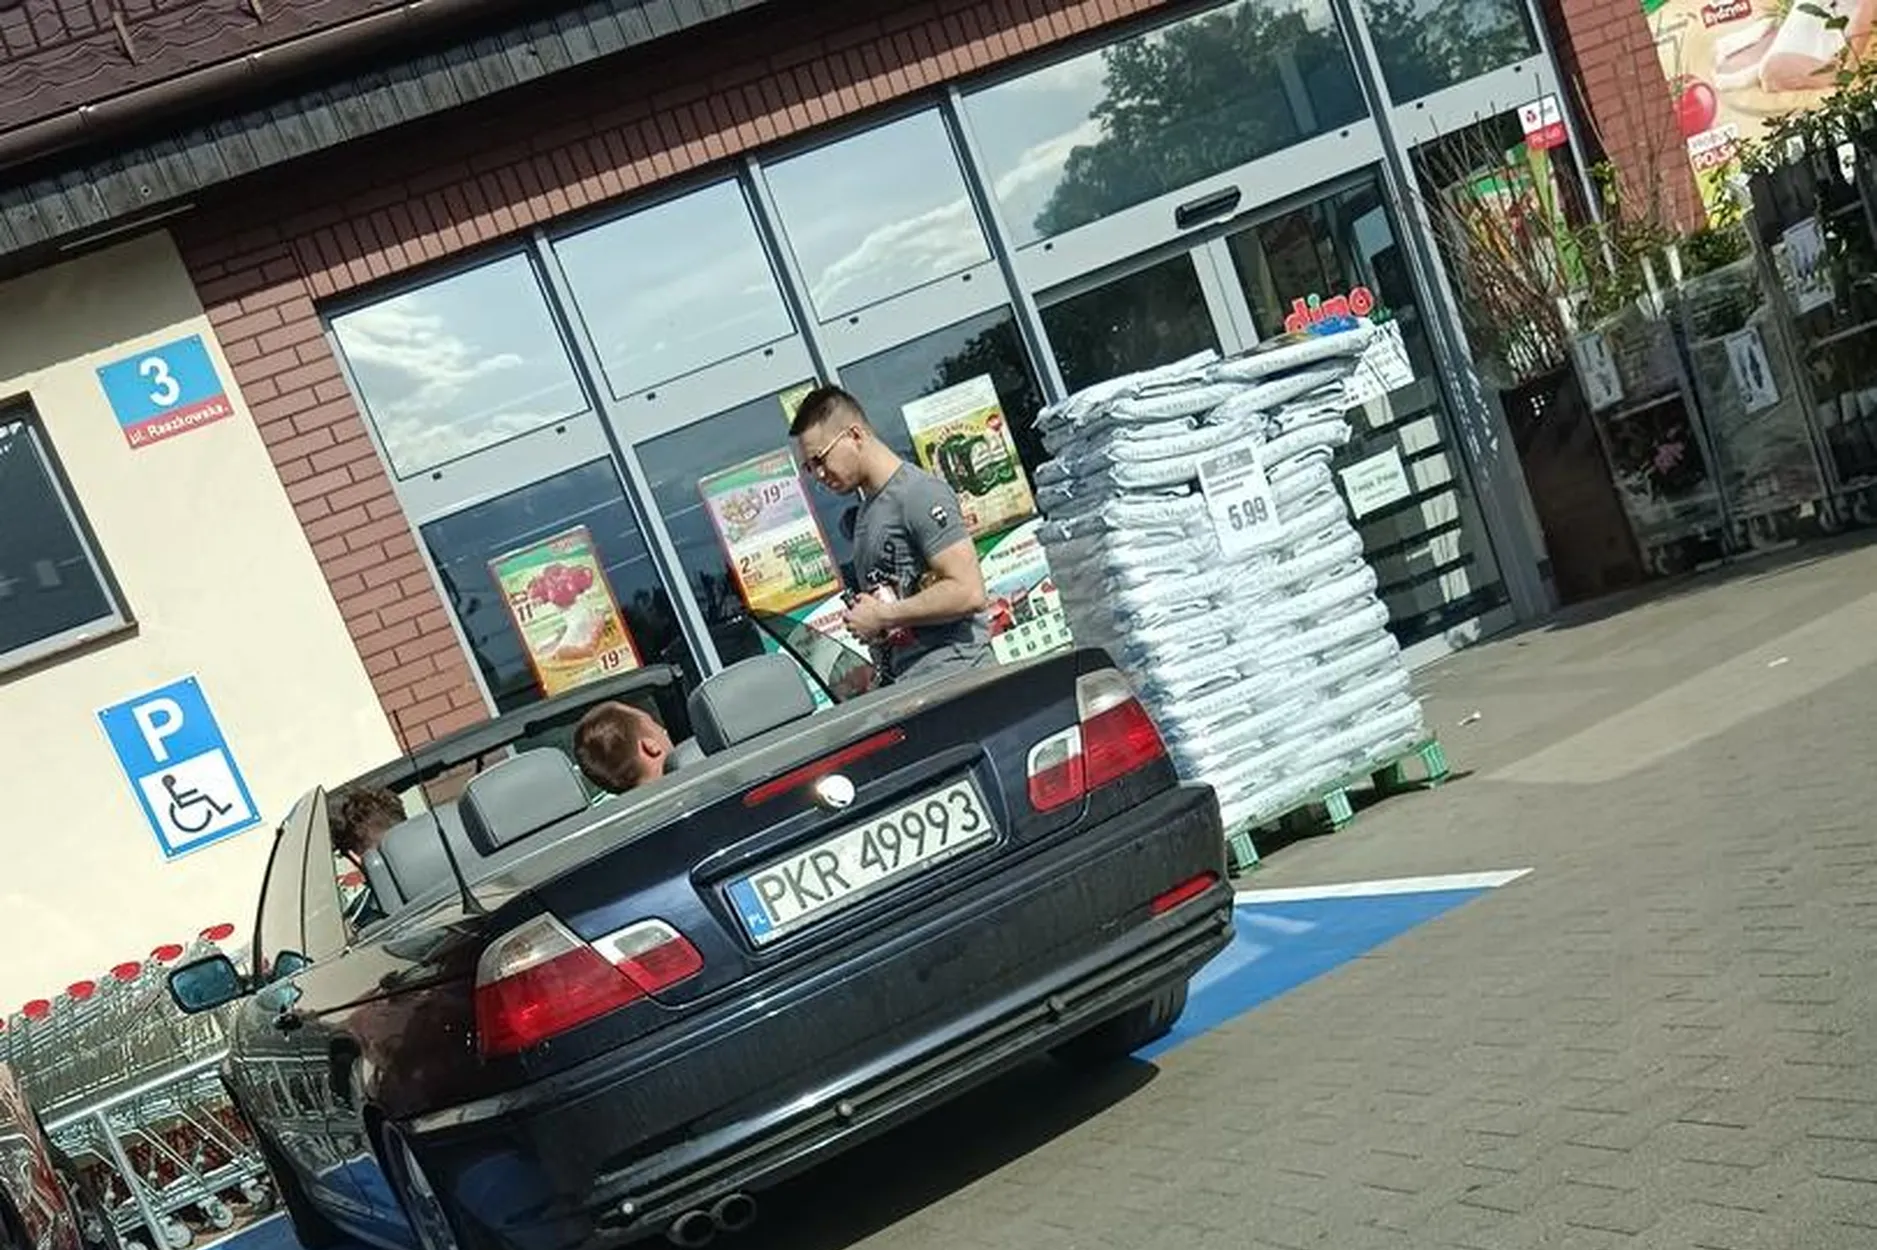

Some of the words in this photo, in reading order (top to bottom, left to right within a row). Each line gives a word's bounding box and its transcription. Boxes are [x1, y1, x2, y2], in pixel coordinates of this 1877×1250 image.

[139, 356, 180, 406] 3
[128, 429, 145, 445] ul.
[147, 404, 223, 438] Raszkowska
[131, 697, 185, 763] P
[754, 848, 851, 922] PKR
[859, 790, 981, 872] 49993
